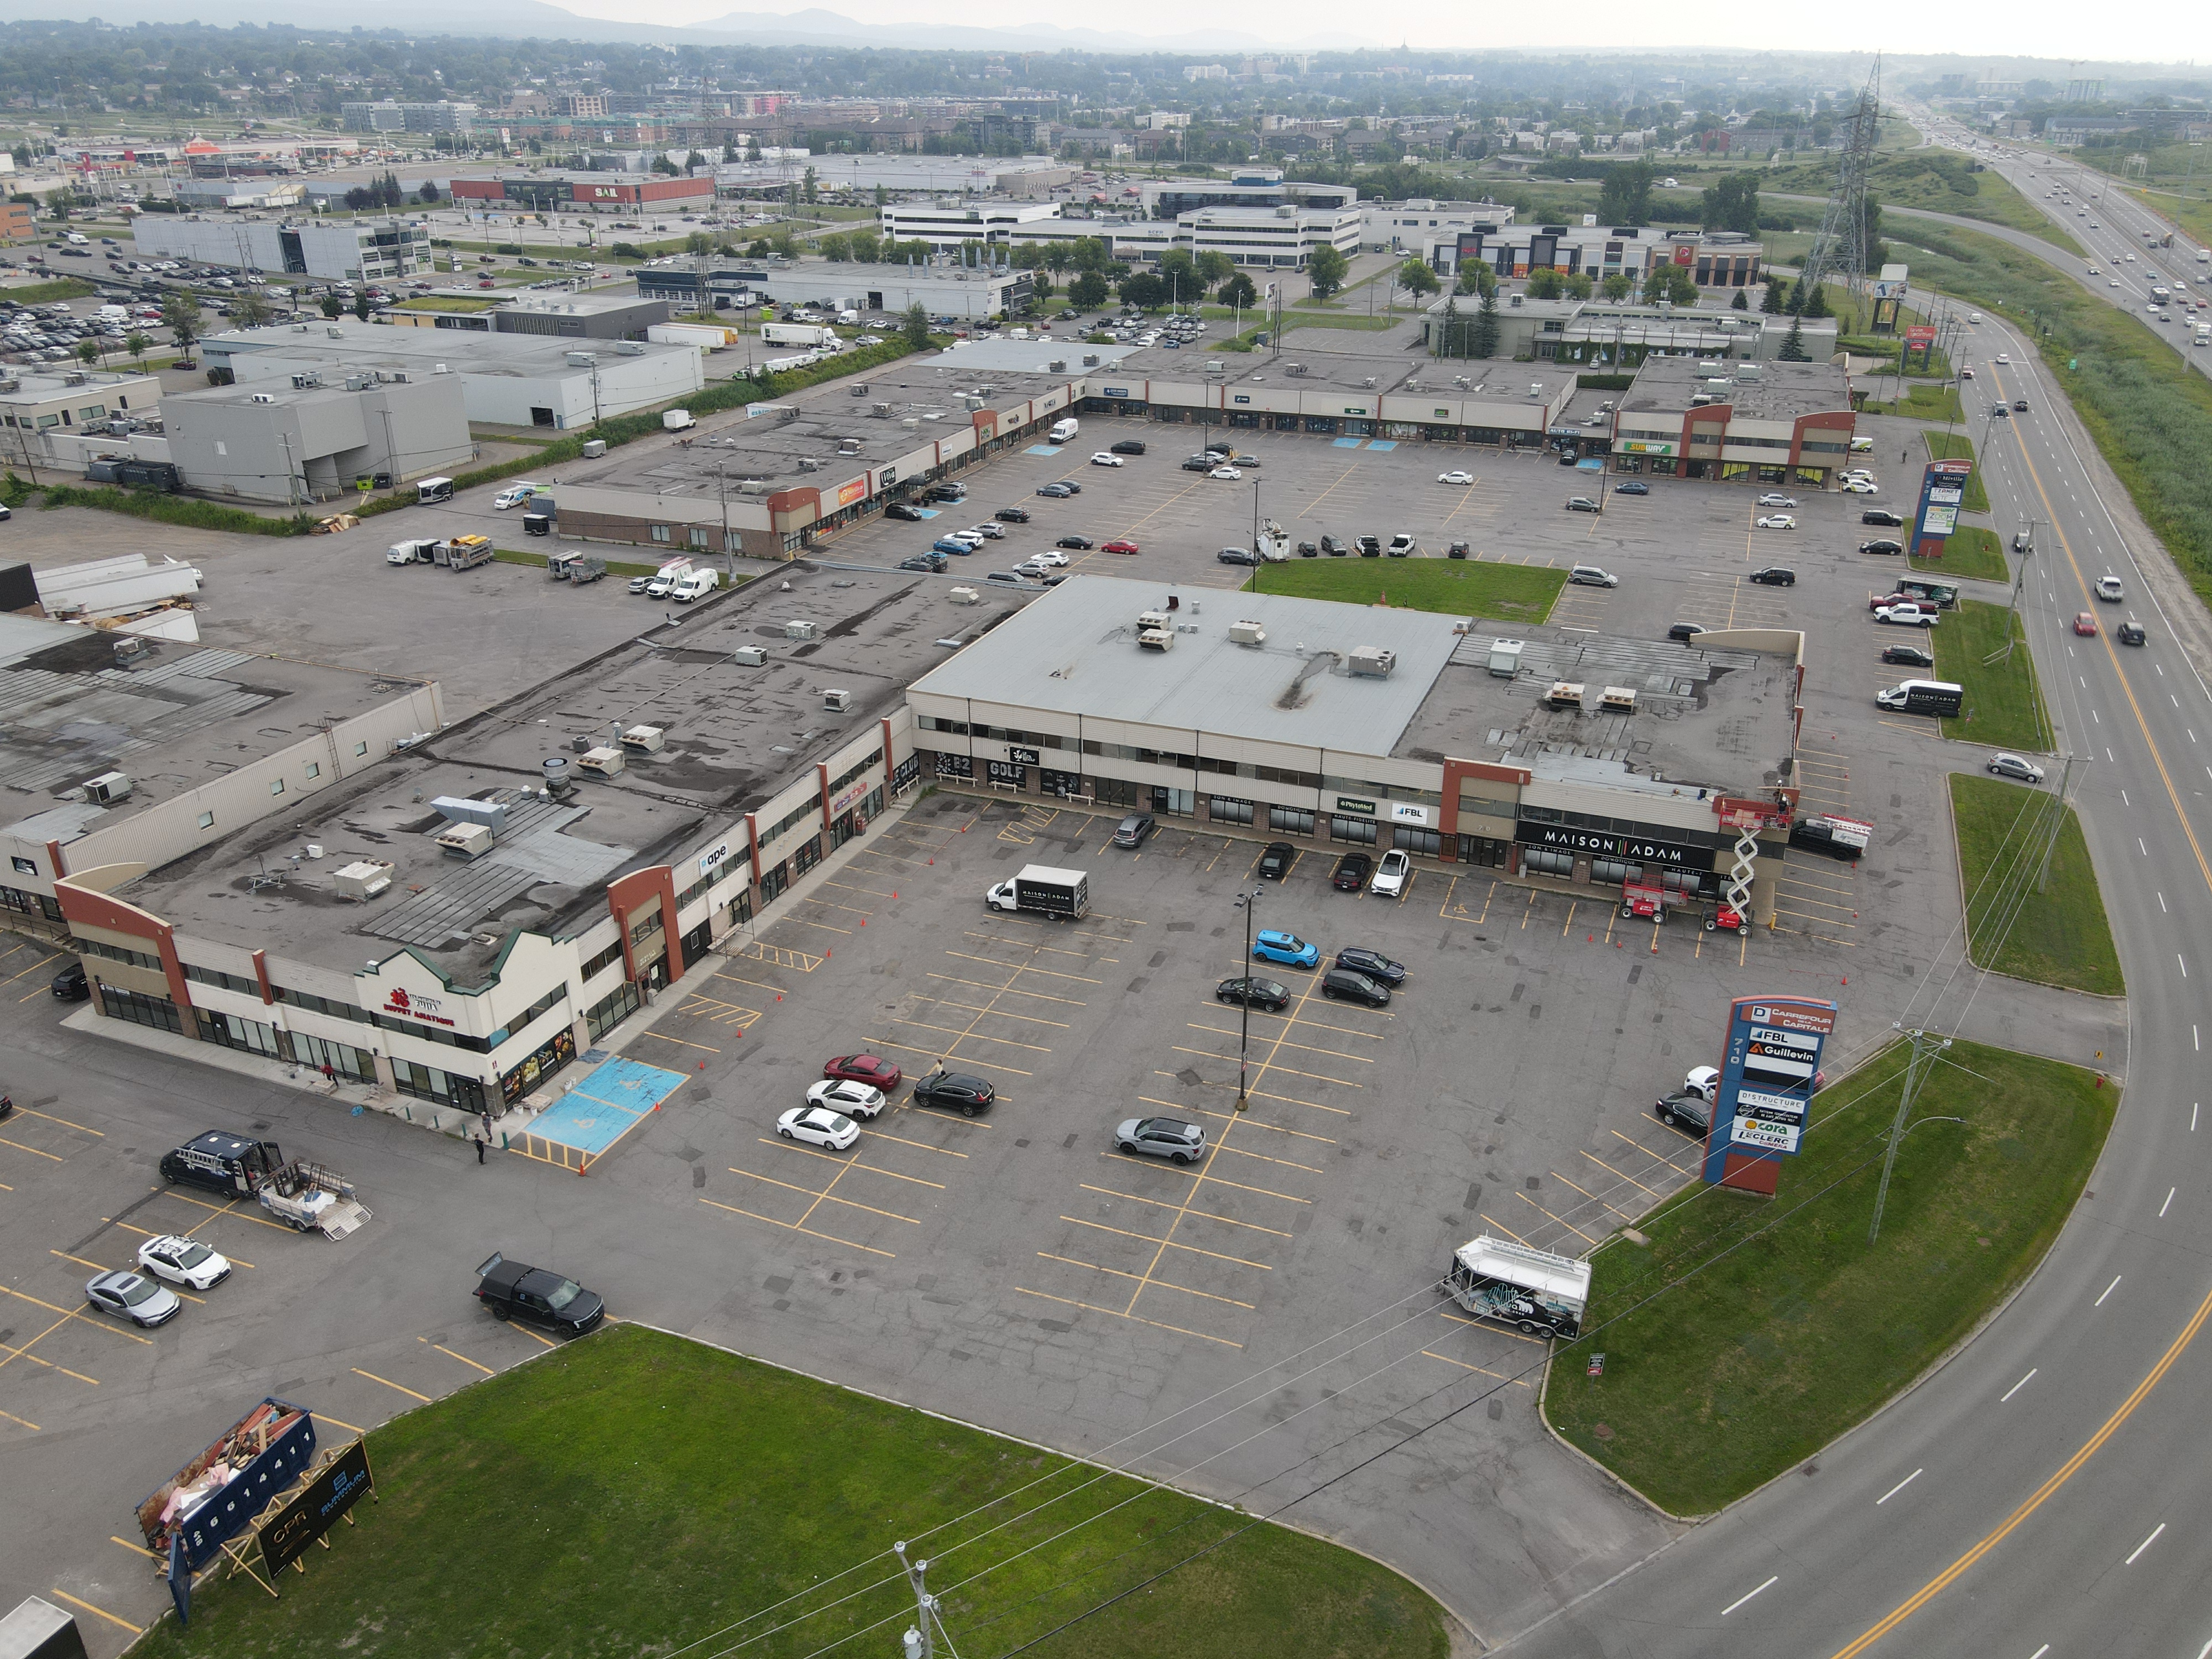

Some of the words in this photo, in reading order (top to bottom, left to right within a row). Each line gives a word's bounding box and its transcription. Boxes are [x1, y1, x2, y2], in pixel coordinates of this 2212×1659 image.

[594, 187, 618, 197] SAIL
[1630, 443, 1666, 453] SUBWAY
[883, 469, 895, 482] Viva
[900, 755, 919, 778] CLUB
[953, 756, 971, 770] B2
[990, 762, 1024, 778] GOLF
[1405, 808, 1423, 817] FBL
[1545, 830, 1615, 851] MAISON
[1630, 844, 1682, 861] ADAM
[707, 845, 727, 865] ape
[1601, 855, 1636, 865] DOMOTIQUE
[414, 999, 437, 1011] FUJIA
[383, 1004, 411, 1016] BUFFET
[414, 1011, 455, 1026] ASIATIQUE
[1753, 1007, 1766, 1017] D
[1772, 1009, 1832, 1024] CARREFOUR
[1783, 1019, 1830, 1033] CAPITALE
[1764, 1031, 1788, 1044] FBL
[1765, 1046, 1813, 1061] Guillevin
[1742, 1092, 1802, 1108] D'STRUCTURE
[1757, 1122, 1788, 1135] cora
[1738, 1131, 1789, 1145] LECLERC
[321, 1469, 365, 1514] SUMMUM
[194, 1531, 203, 1547] 418
